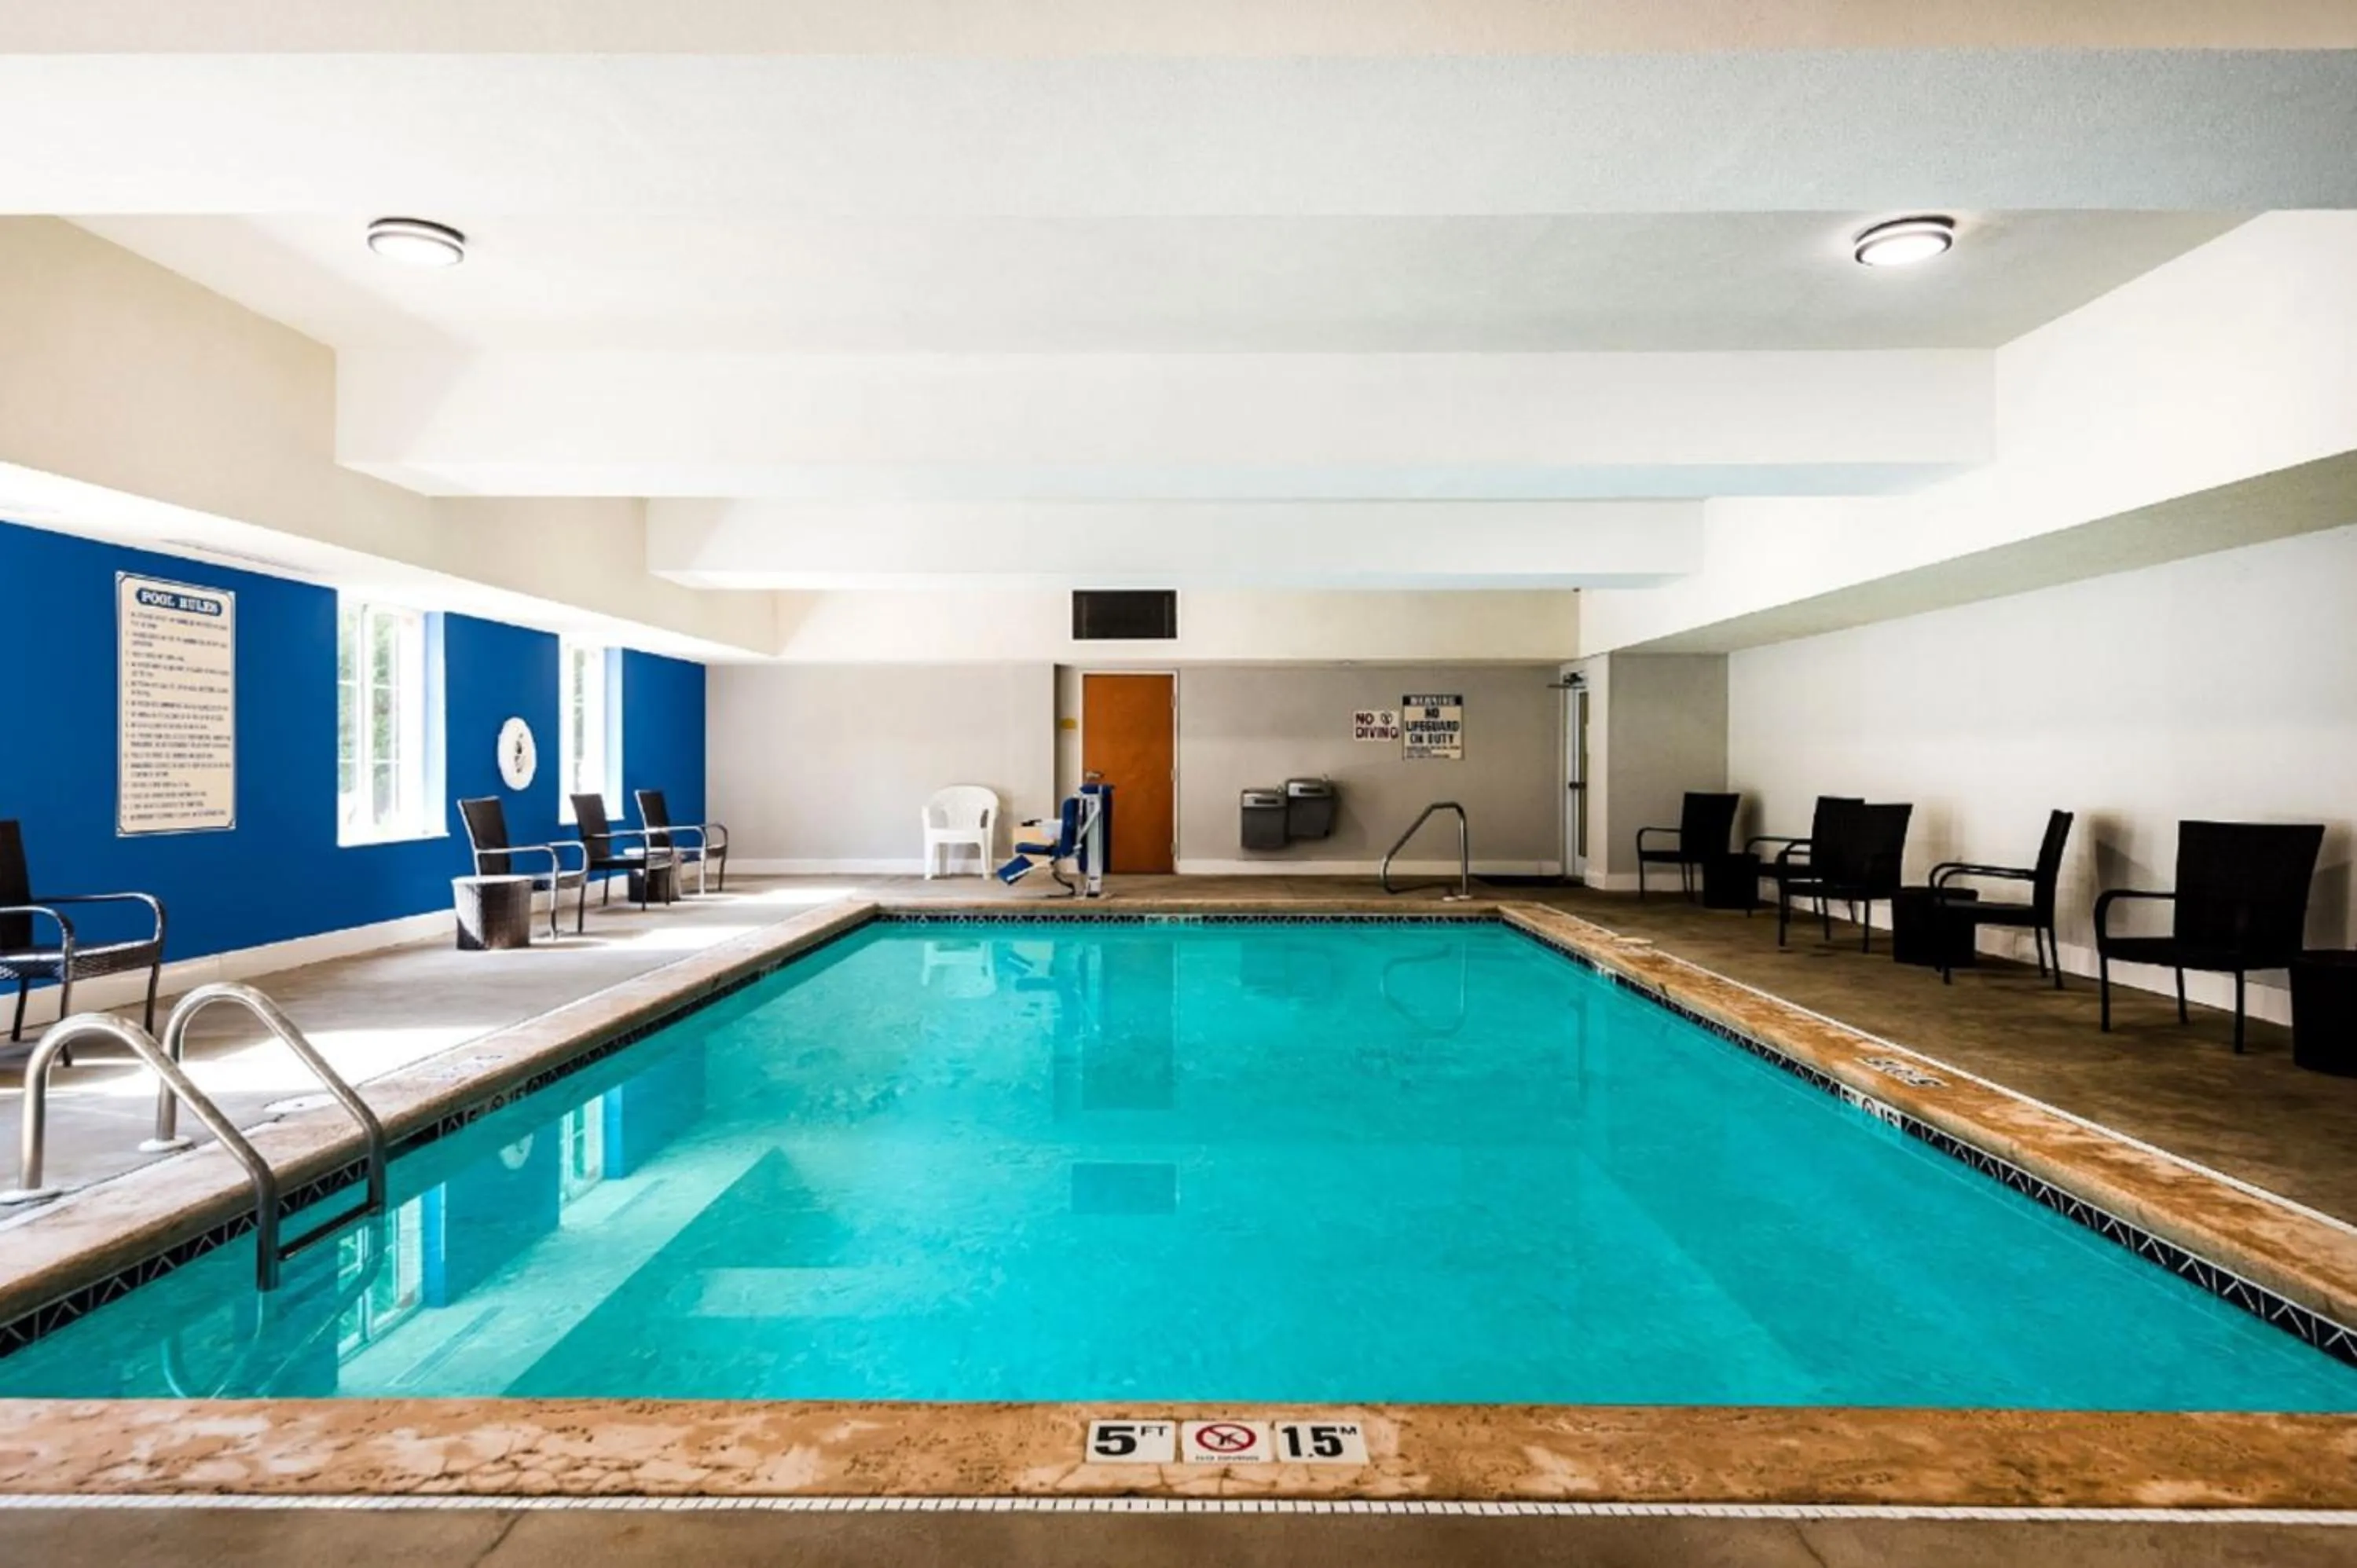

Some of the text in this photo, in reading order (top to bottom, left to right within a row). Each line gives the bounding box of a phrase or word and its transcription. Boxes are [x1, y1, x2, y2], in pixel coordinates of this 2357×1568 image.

[141, 591, 218, 613] POOL RULES
[1355, 713, 1374, 724] NO
[1425, 708, 1439, 718] NO
[1406, 720, 1460, 731] LIFEGUARD
[1355, 727, 1398, 738] DIVING
[1410, 733, 1453, 744] ON DUTY
